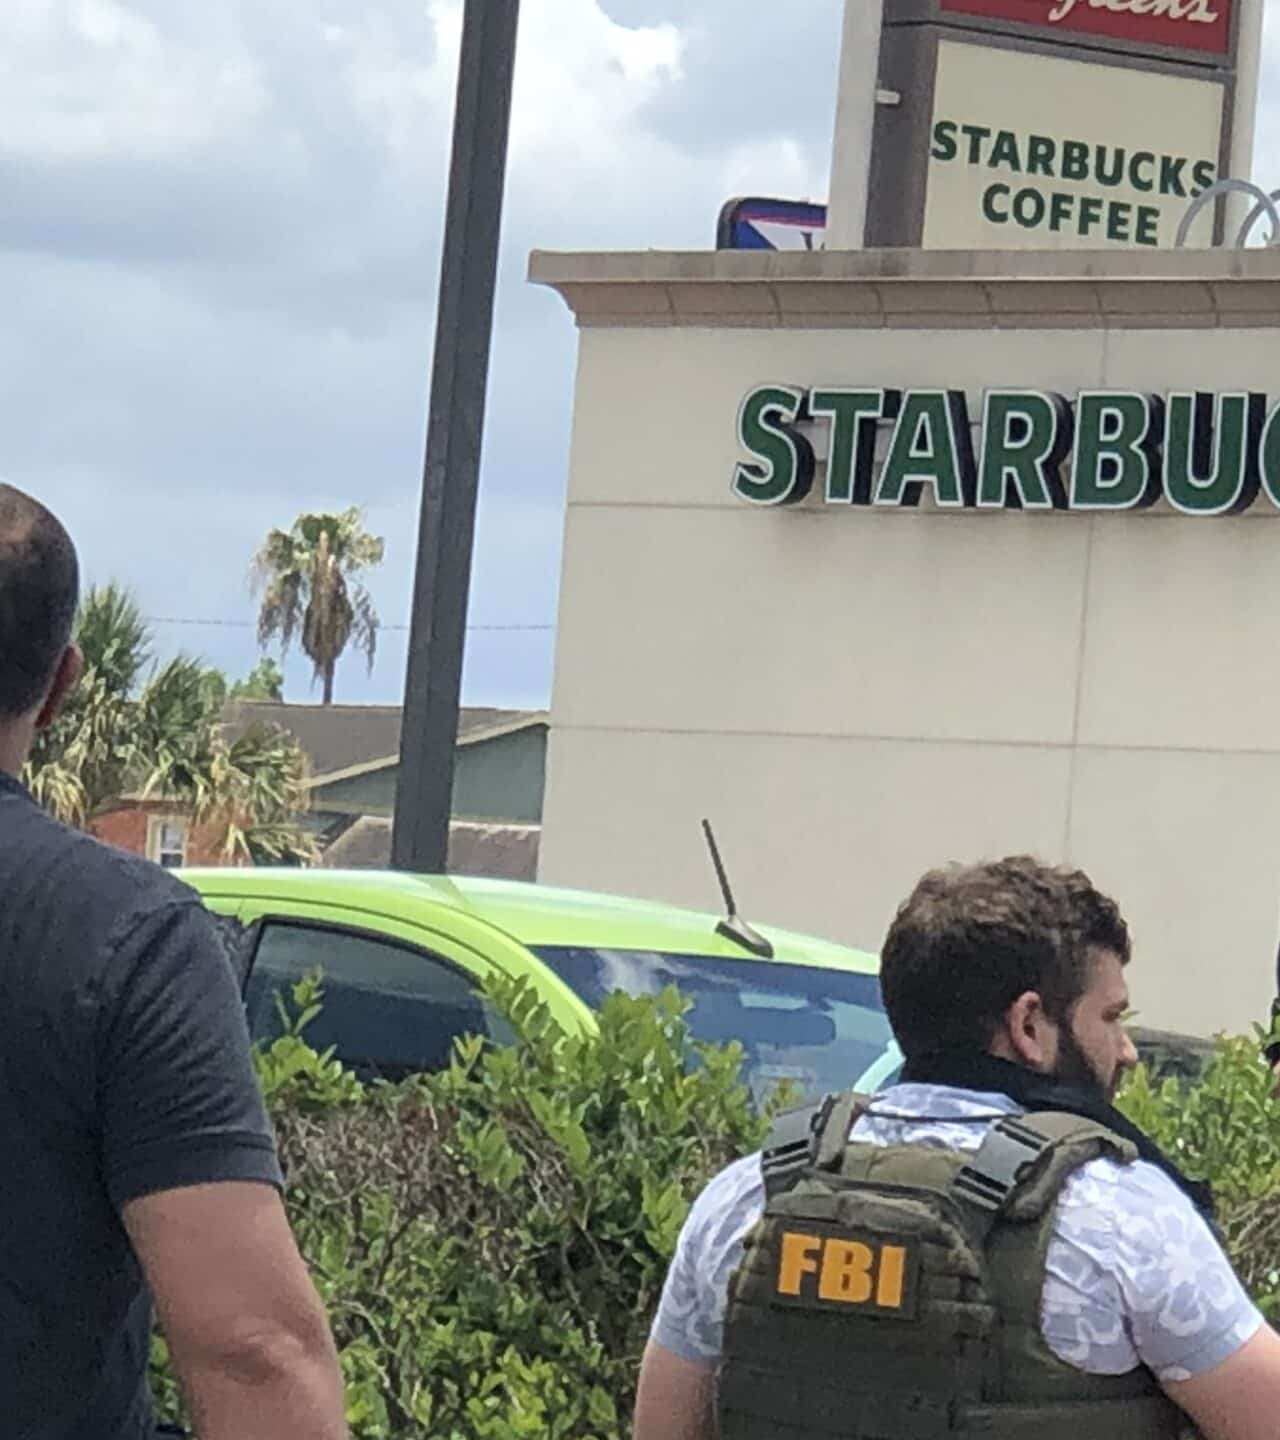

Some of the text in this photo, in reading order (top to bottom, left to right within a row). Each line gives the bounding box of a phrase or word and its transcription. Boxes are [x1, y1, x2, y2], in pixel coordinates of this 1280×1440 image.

[930, 119, 1219, 200] STARBUCKS
[981, 183, 1161, 247] COFFEE
[776, 1231, 907, 1309] FBI
